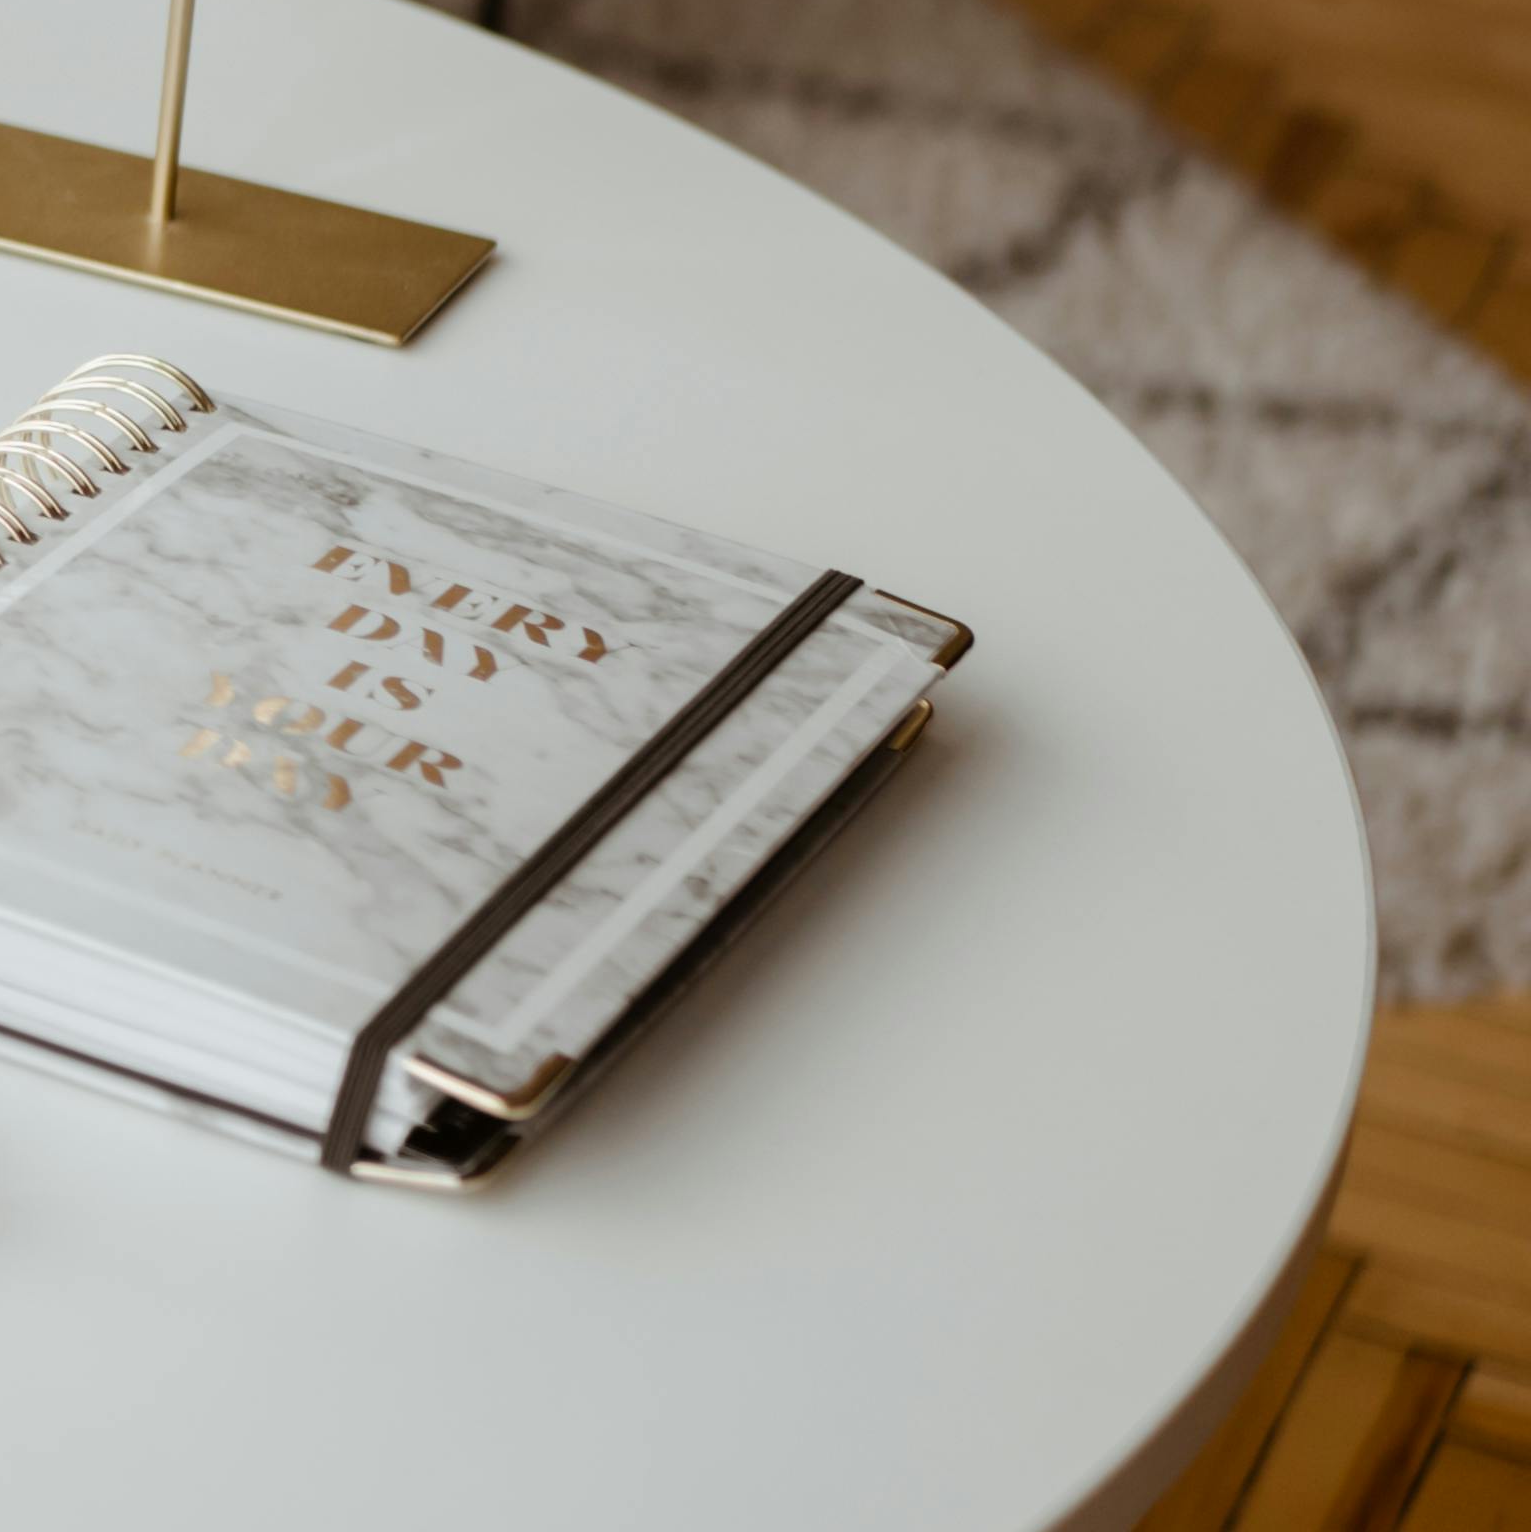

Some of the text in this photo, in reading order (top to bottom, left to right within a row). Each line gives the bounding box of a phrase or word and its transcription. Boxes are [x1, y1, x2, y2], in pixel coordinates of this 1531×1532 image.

[311, 545, 644, 664] EVERY
[327, 604, 521, 682] DAY
[203, 670, 464, 790] YOUR
[327, 660, 435, 711] IS
